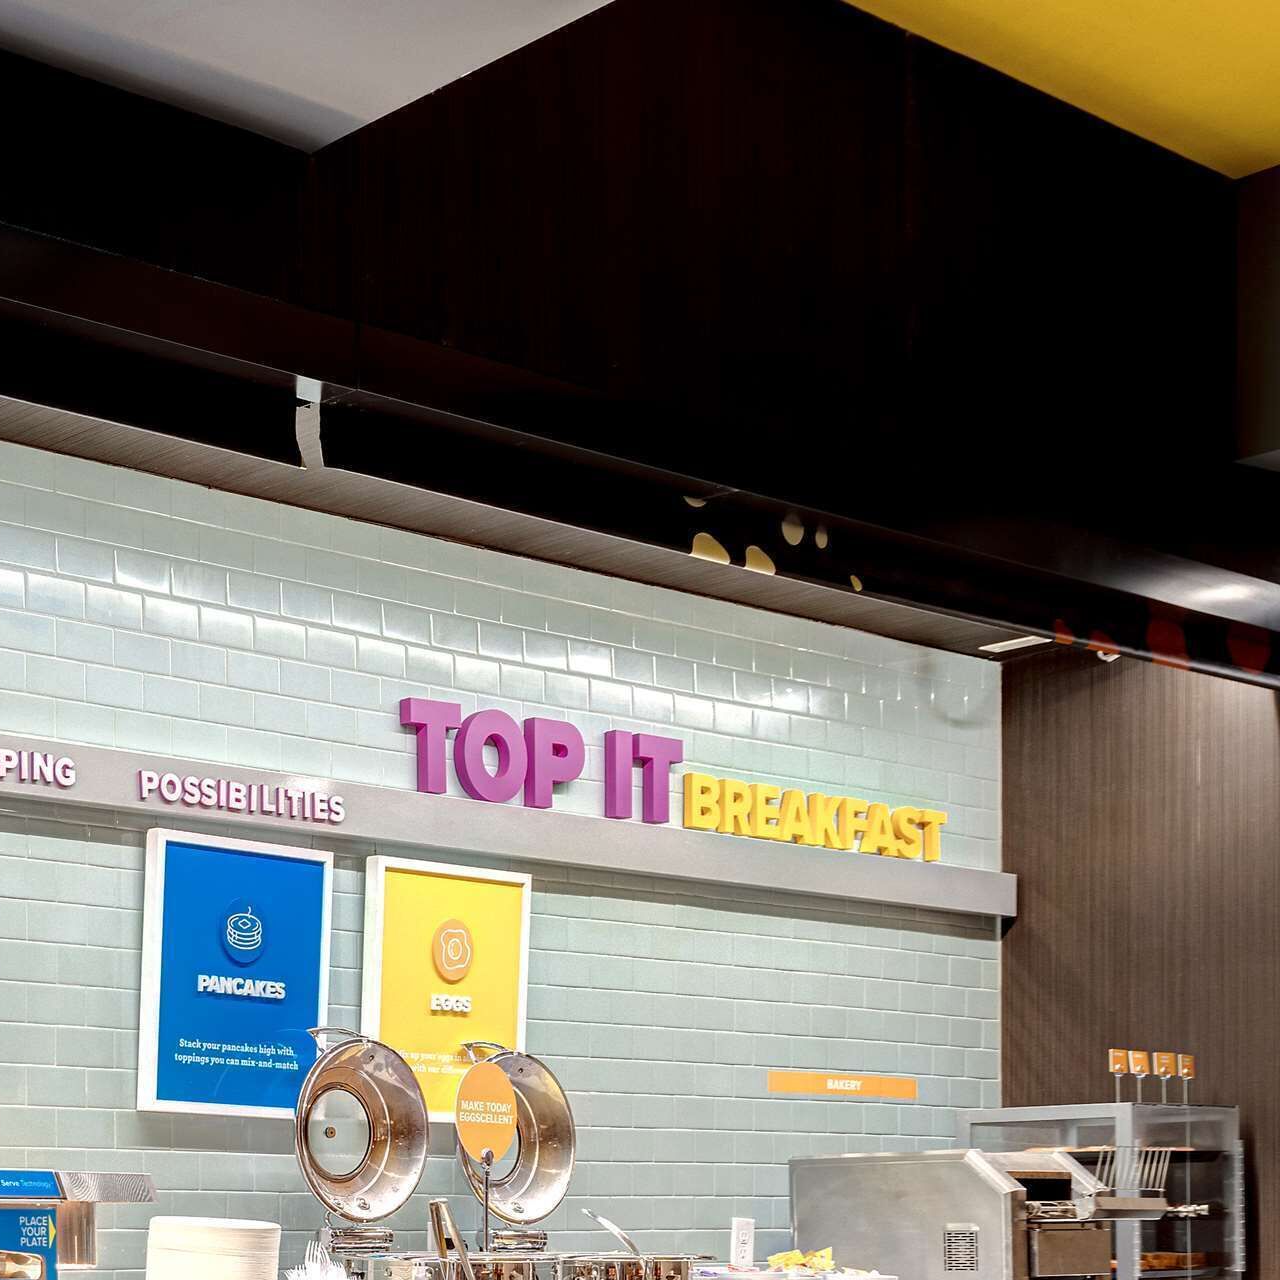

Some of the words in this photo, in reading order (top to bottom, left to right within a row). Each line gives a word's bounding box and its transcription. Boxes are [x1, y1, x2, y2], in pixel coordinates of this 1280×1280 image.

[399, 697, 585, 809] TOP
[604, 729, 684, 825] IT
[138, 767, 347, 824] POSSIBILITIES
[682, 771, 949, 863] BREAKFAST
[197, 974, 286, 1000] PANCAKES
[431, 993, 472, 1013] EGGS
[179, 1038, 201, 1049] Stack
[202, 1041, 221, 1051] your
[222, 1043, 257, 1054] pancakes
[259, 1045, 276, 1057] high
[277, 1046, 294, 1056] with
[174, 1053, 209, 1065] toppings
[210, 1056, 224, 1065] you
[225, 1057, 240, 1065] can
[241, 1057, 299, 1071] mix-and-match
[826, 1079, 863, 1090] BAKERY
[461, 1100, 485, 1111] MAKE
[486, 1102, 512, 1113] TODAY
[460, 1111, 514, 1125] EGGSCELLENT
[1, 1179, 20, 1187] Serve
[19, 1216, 48, 1226] PLACE
[21, 1226, 48, 1236] YOUR
[20, 1237, 48, 1247] PLATE
